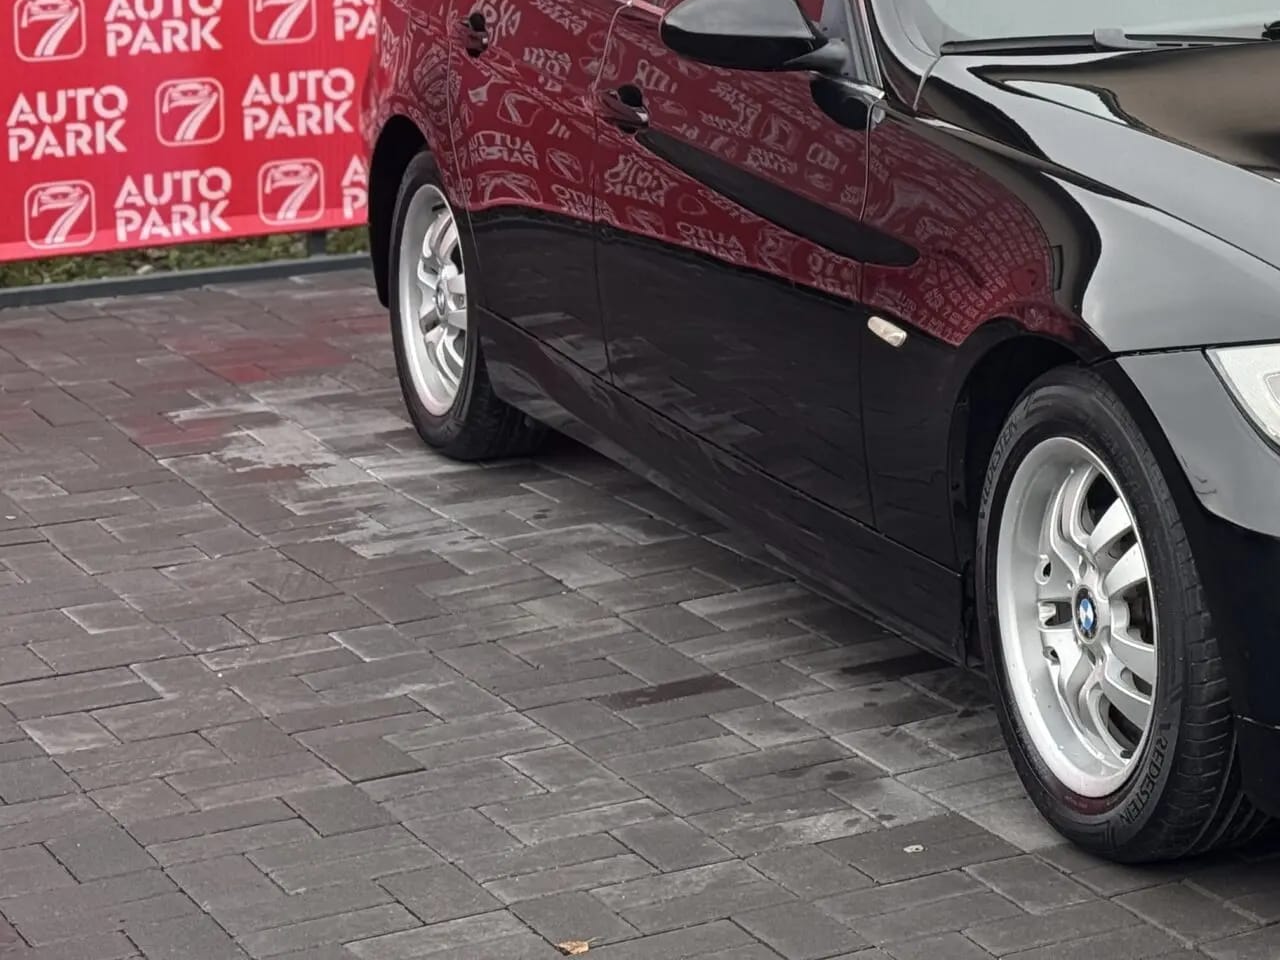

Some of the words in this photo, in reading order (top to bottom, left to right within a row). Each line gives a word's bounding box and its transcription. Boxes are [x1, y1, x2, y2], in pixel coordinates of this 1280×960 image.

[106, 16, 221, 56] PARK
[7, 85, 128, 125] AUTO
[242, 68, 355, 105] AUTO
[242, 100, 353, 140] PARK
[9, 120, 126, 161] PARK
[115, 167, 231, 207] AUTO
[116, 200, 232, 242] PARK
